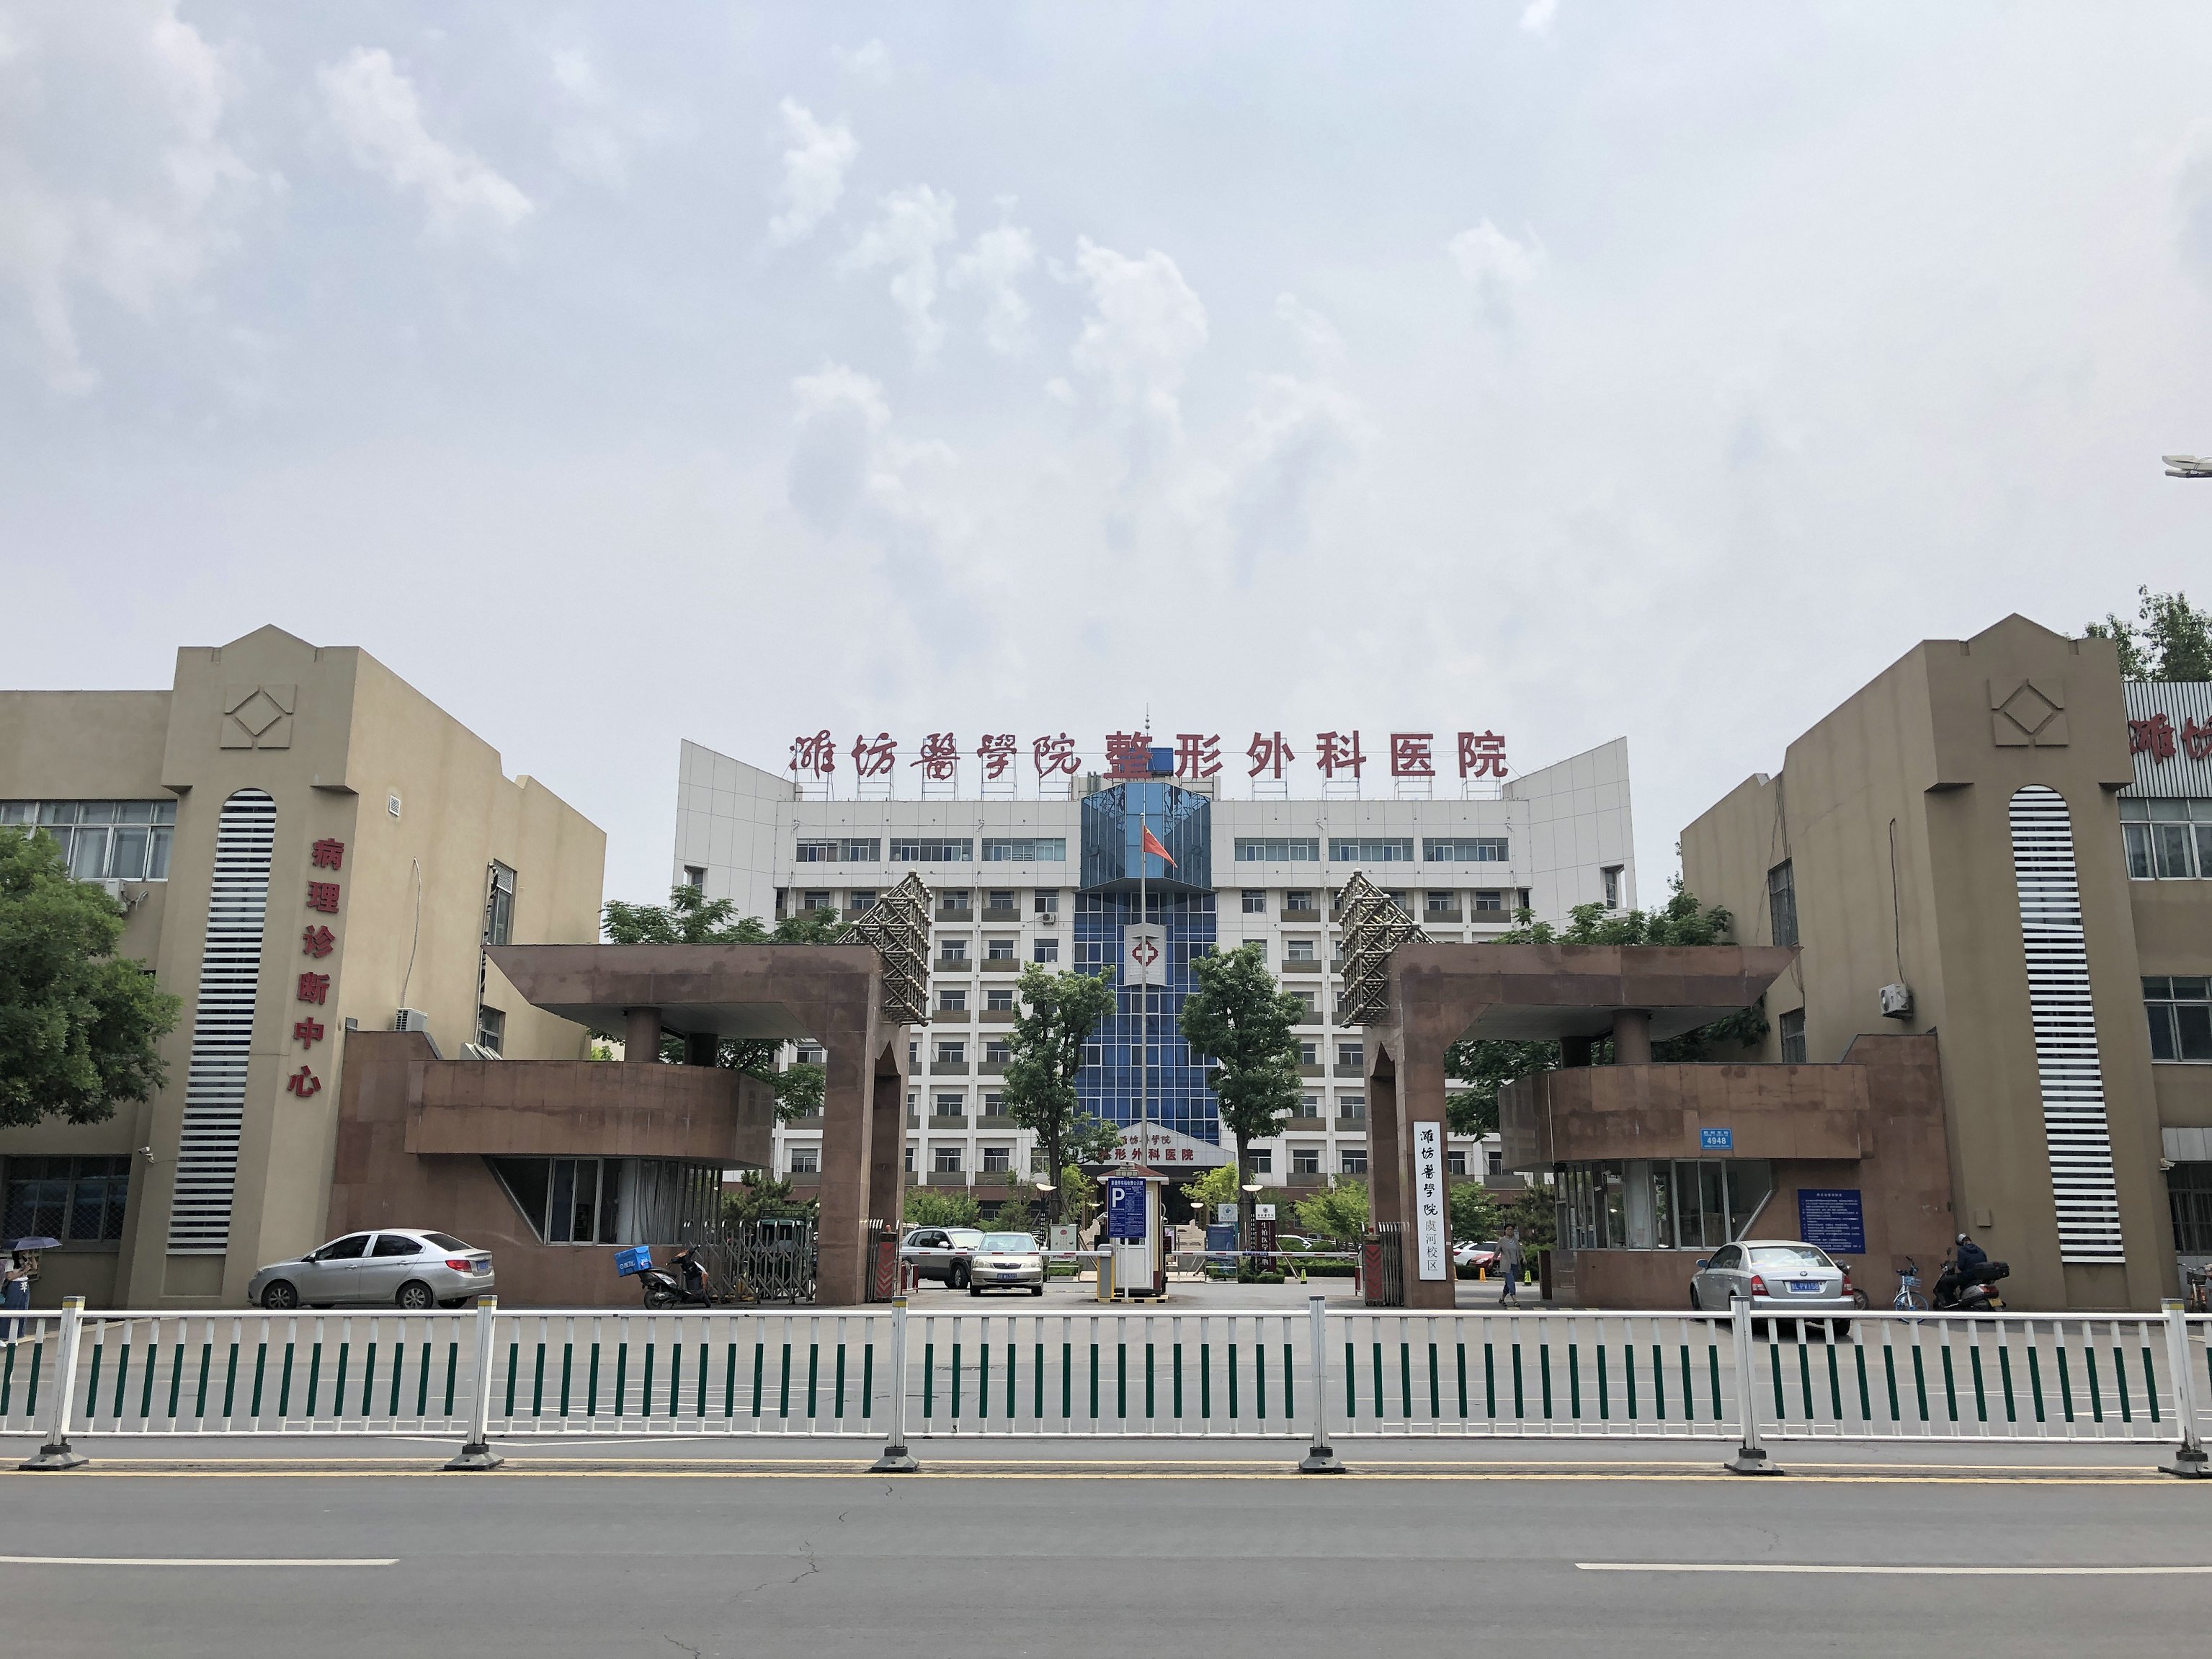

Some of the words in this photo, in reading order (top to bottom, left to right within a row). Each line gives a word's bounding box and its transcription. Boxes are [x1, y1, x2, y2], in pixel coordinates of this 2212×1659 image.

[287, 837, 344, 1097] 病理诊断中心
[1112, 1187, 1125, 1208] P
